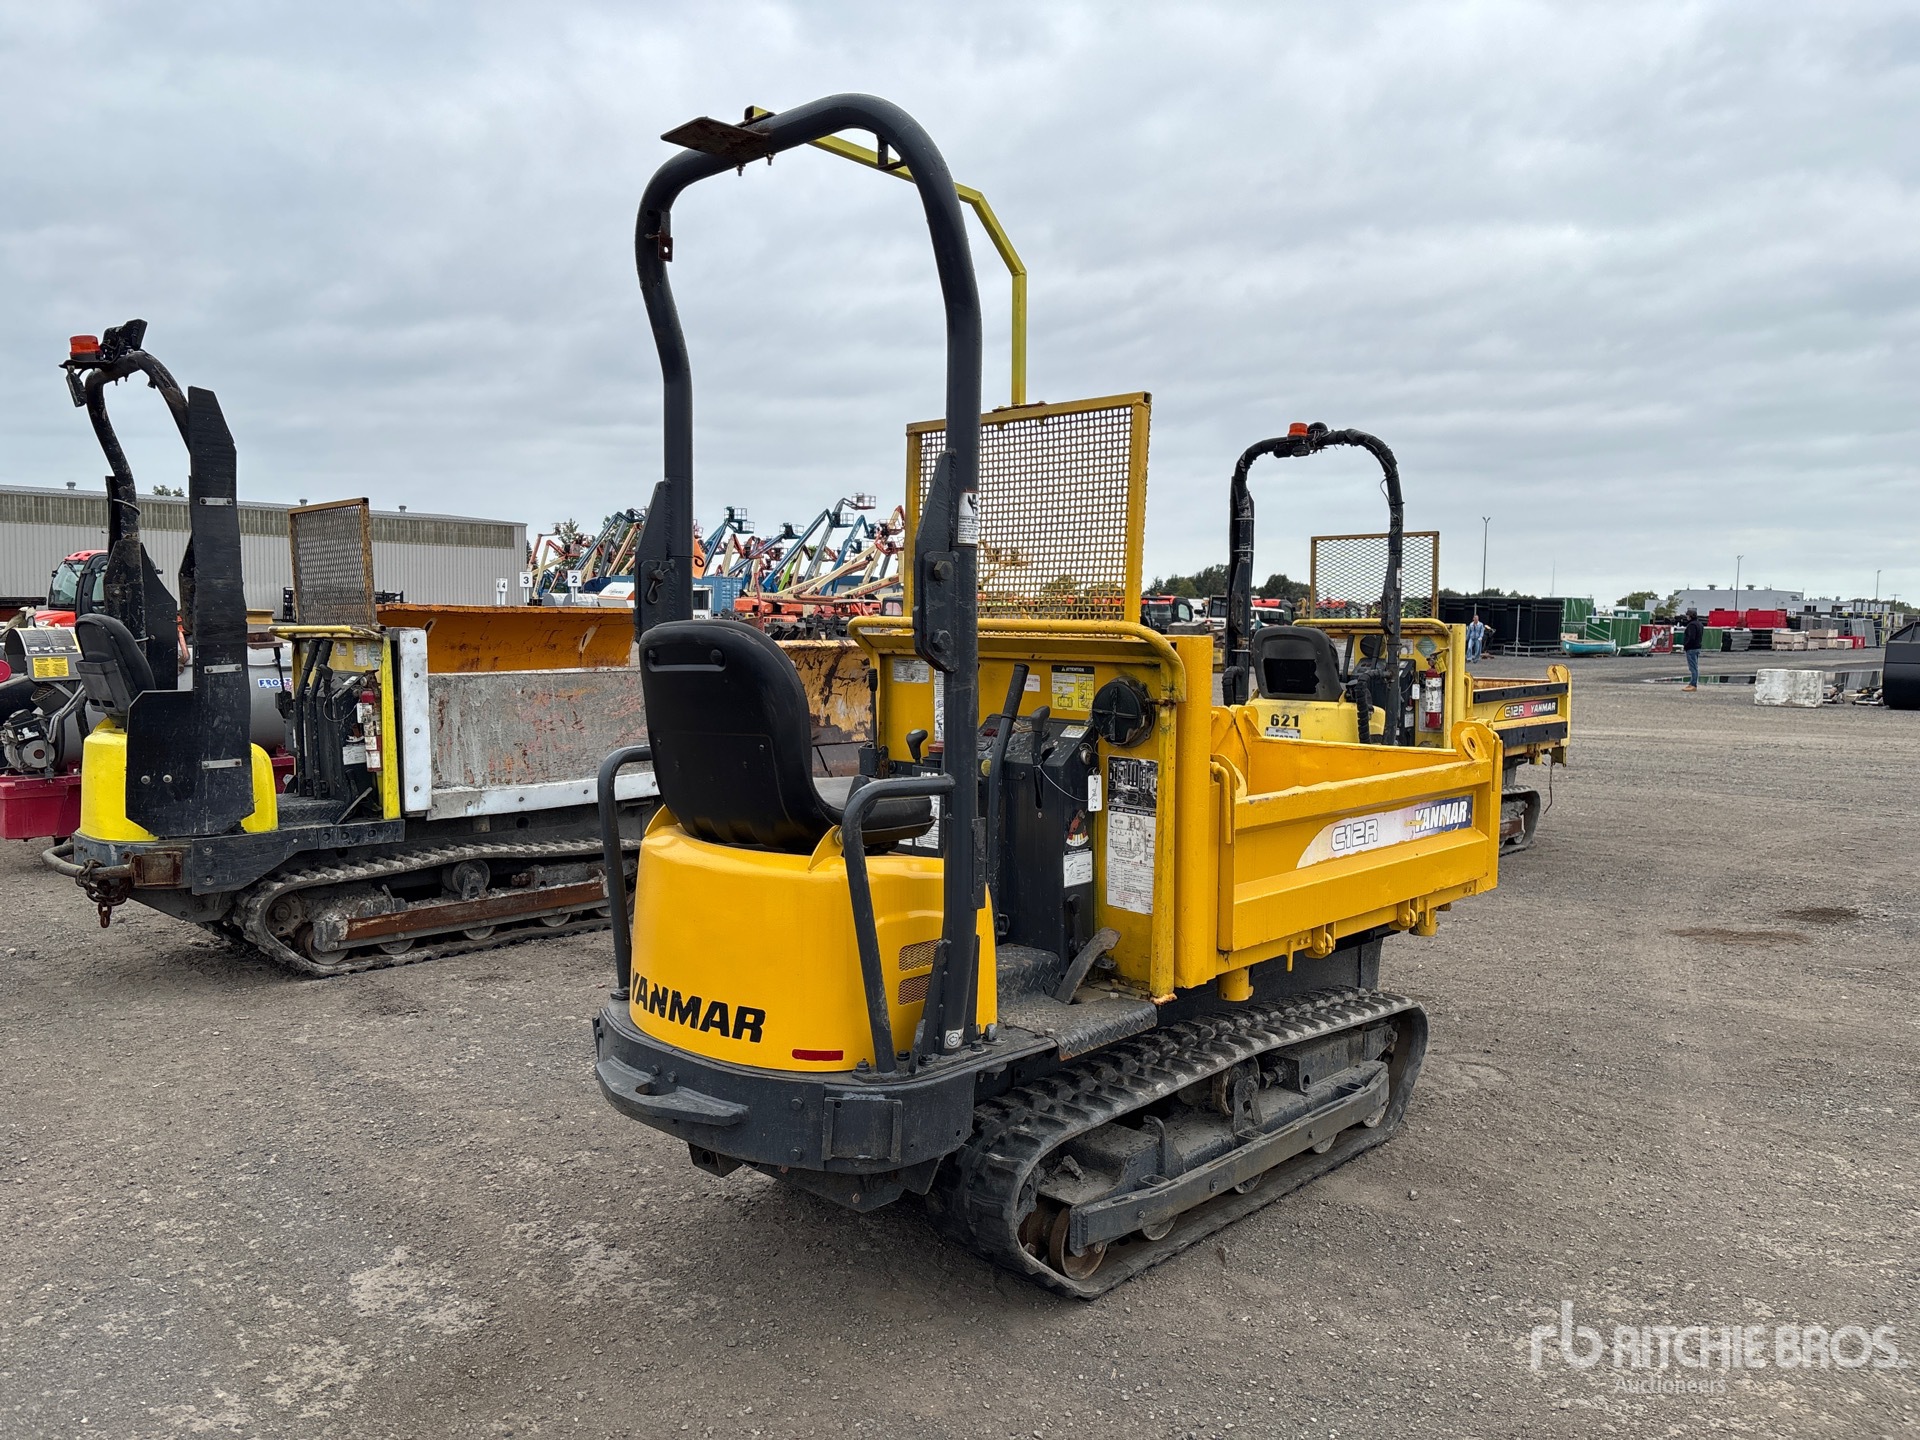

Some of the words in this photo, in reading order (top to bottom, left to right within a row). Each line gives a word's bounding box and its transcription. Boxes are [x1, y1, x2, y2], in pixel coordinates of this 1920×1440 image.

[572, 576, 578, 584] 2
[1504, 704, 1524, 717] C12R
[1530, 702, 1556, 713] YANMAR
[1270, 714, 1299, 727] 621
[1331, 818, 1378, 852] C12R
[1414, 800, 1468, 834] YANMAR
[631, 968, 766, 1043] YANMAR
